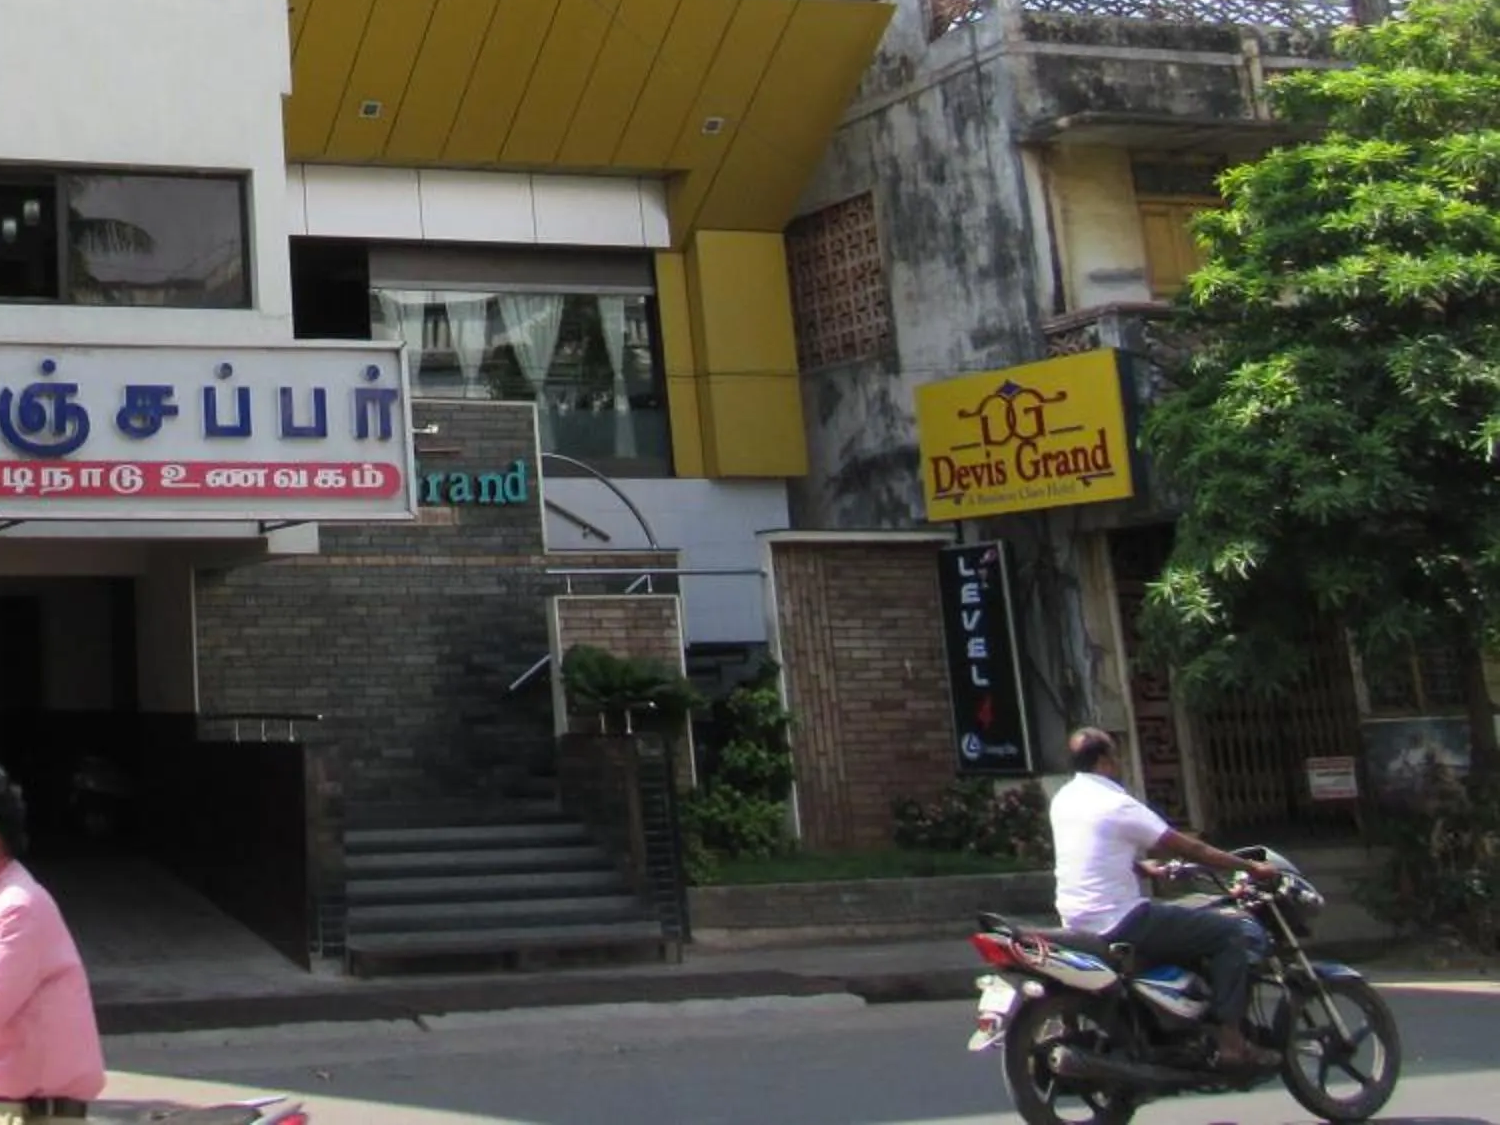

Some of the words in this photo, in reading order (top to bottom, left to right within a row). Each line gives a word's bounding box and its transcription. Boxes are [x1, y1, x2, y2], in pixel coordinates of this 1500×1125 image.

[415, 459, 528, 502] rand
[932, 451, 1006, 493] Devis
[1016, 428, 1112, 481] Grand
[957, 555, 990, 687] LEVEL
